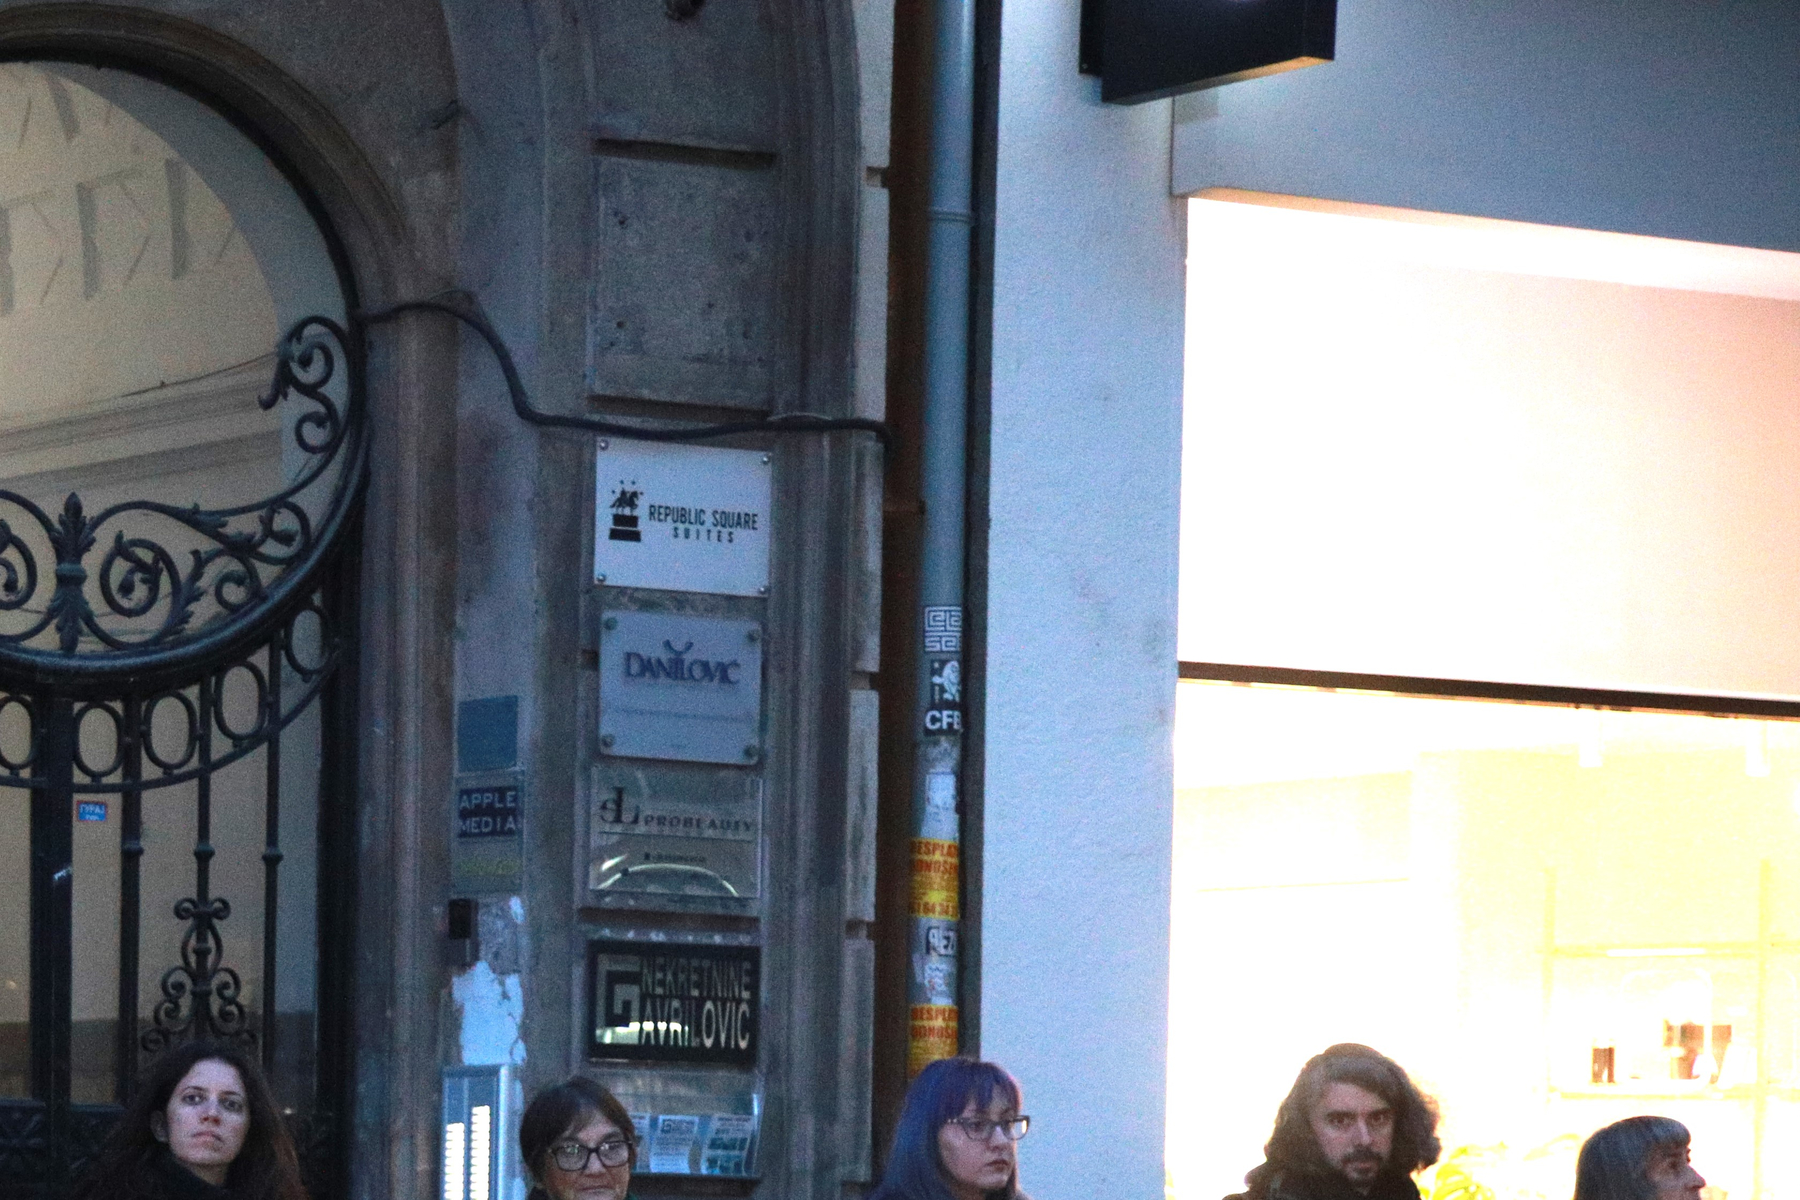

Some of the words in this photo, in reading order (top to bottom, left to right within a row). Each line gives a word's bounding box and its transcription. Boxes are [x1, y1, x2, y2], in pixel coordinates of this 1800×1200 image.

[649, 504, 706, 526] REPUBLIC
[711, 510, 758, 531] SQUARE
[673, 526, 734, 543] SUITES
[460, 791, 516, 810] APPLE
[459, 815, 516, 833] MEDIA
[642, 956, 751, 999] NEKRETNINE
